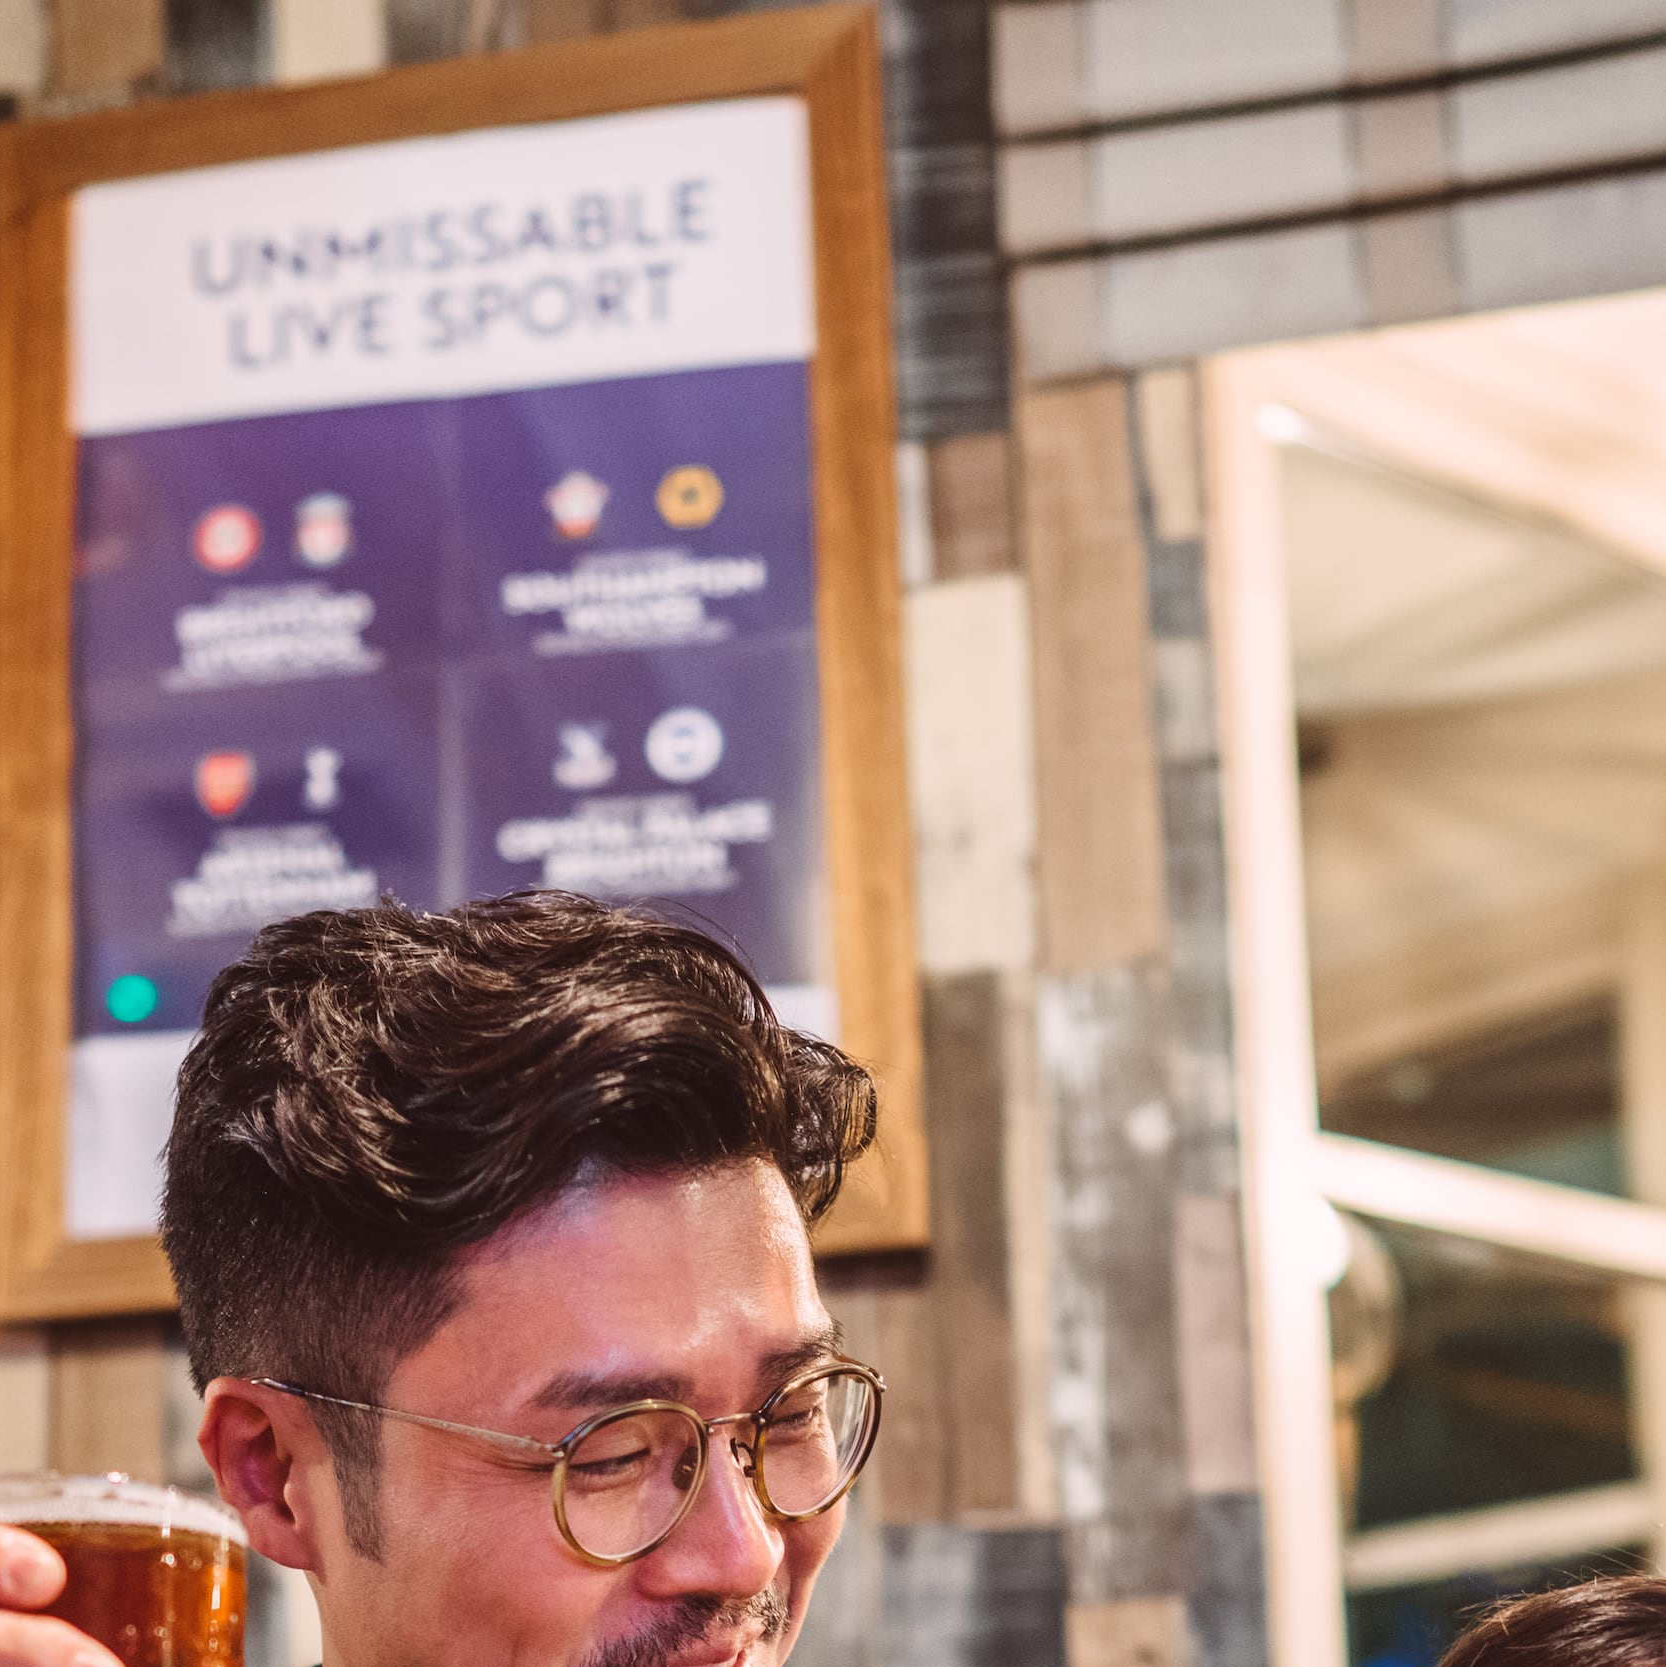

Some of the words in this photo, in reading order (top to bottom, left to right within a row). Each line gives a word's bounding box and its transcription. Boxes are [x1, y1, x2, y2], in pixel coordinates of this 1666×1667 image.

[190, 178, 713, 300] UNMISSABLE
[226, 291, 395, 370] LIVE
[420, 261, 676, 353] SPORT
